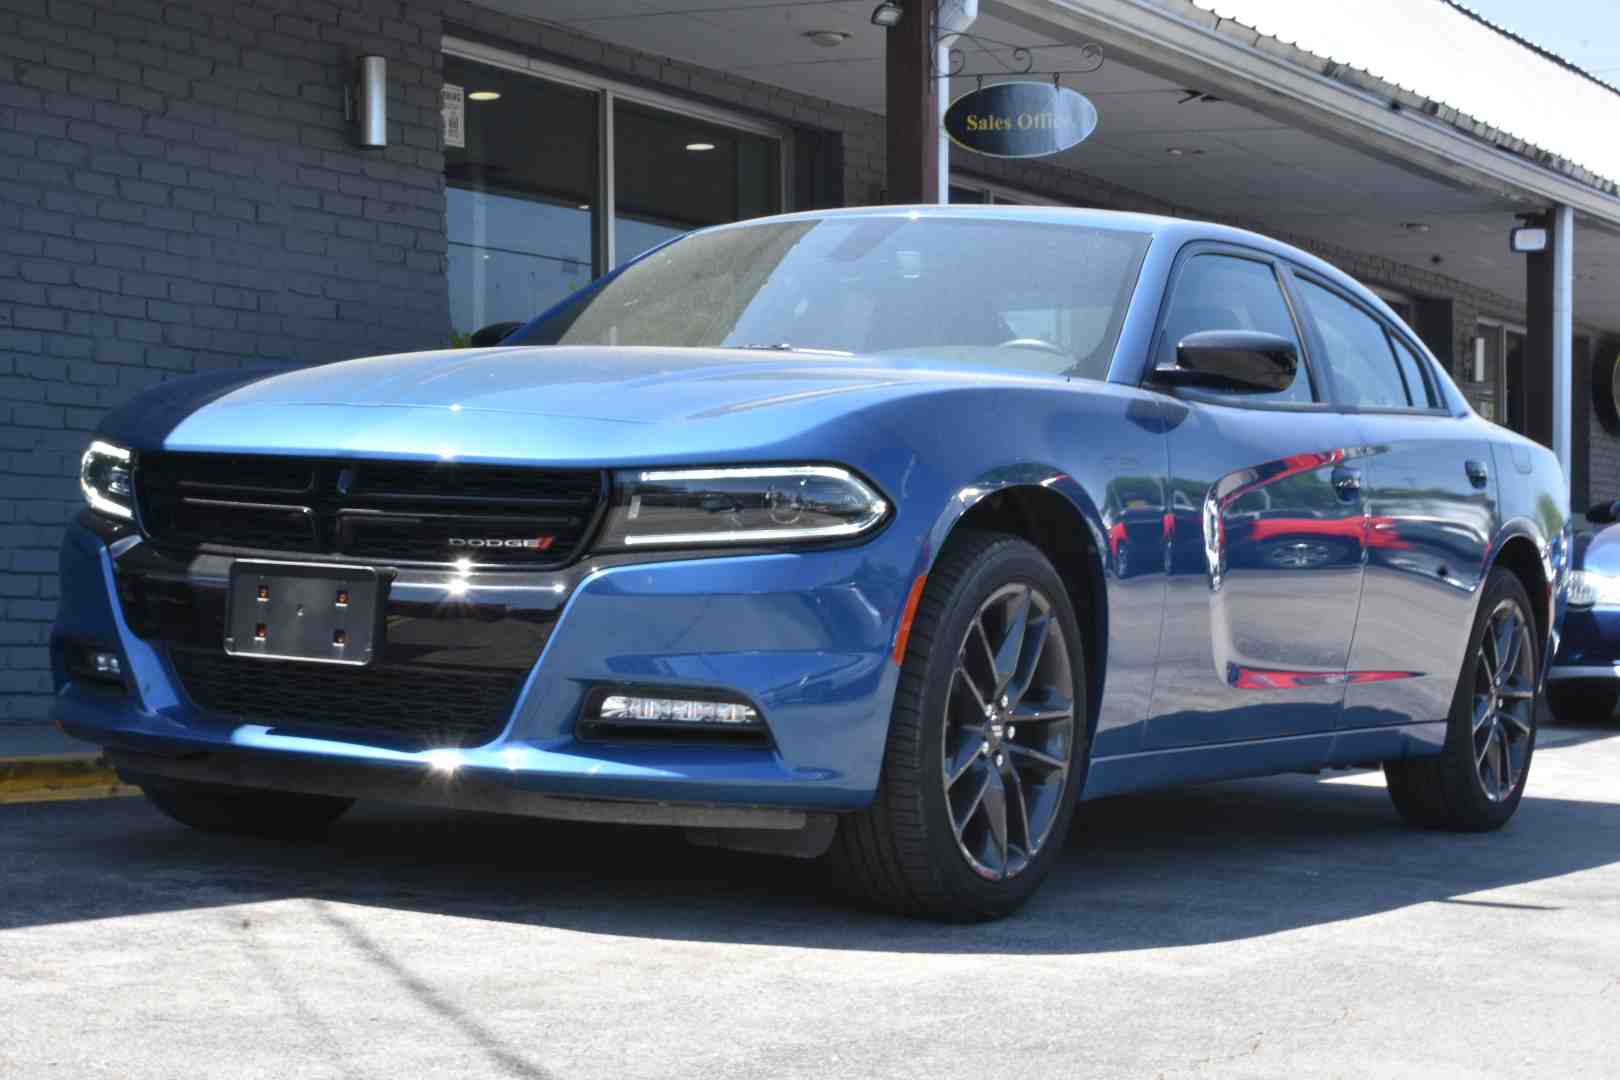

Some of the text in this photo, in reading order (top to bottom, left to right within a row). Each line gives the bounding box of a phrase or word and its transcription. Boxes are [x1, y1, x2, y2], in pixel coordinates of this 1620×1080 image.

[966, 112, 1071, 130] Sales Offi
[448, 537, 540, 548] DODGE
